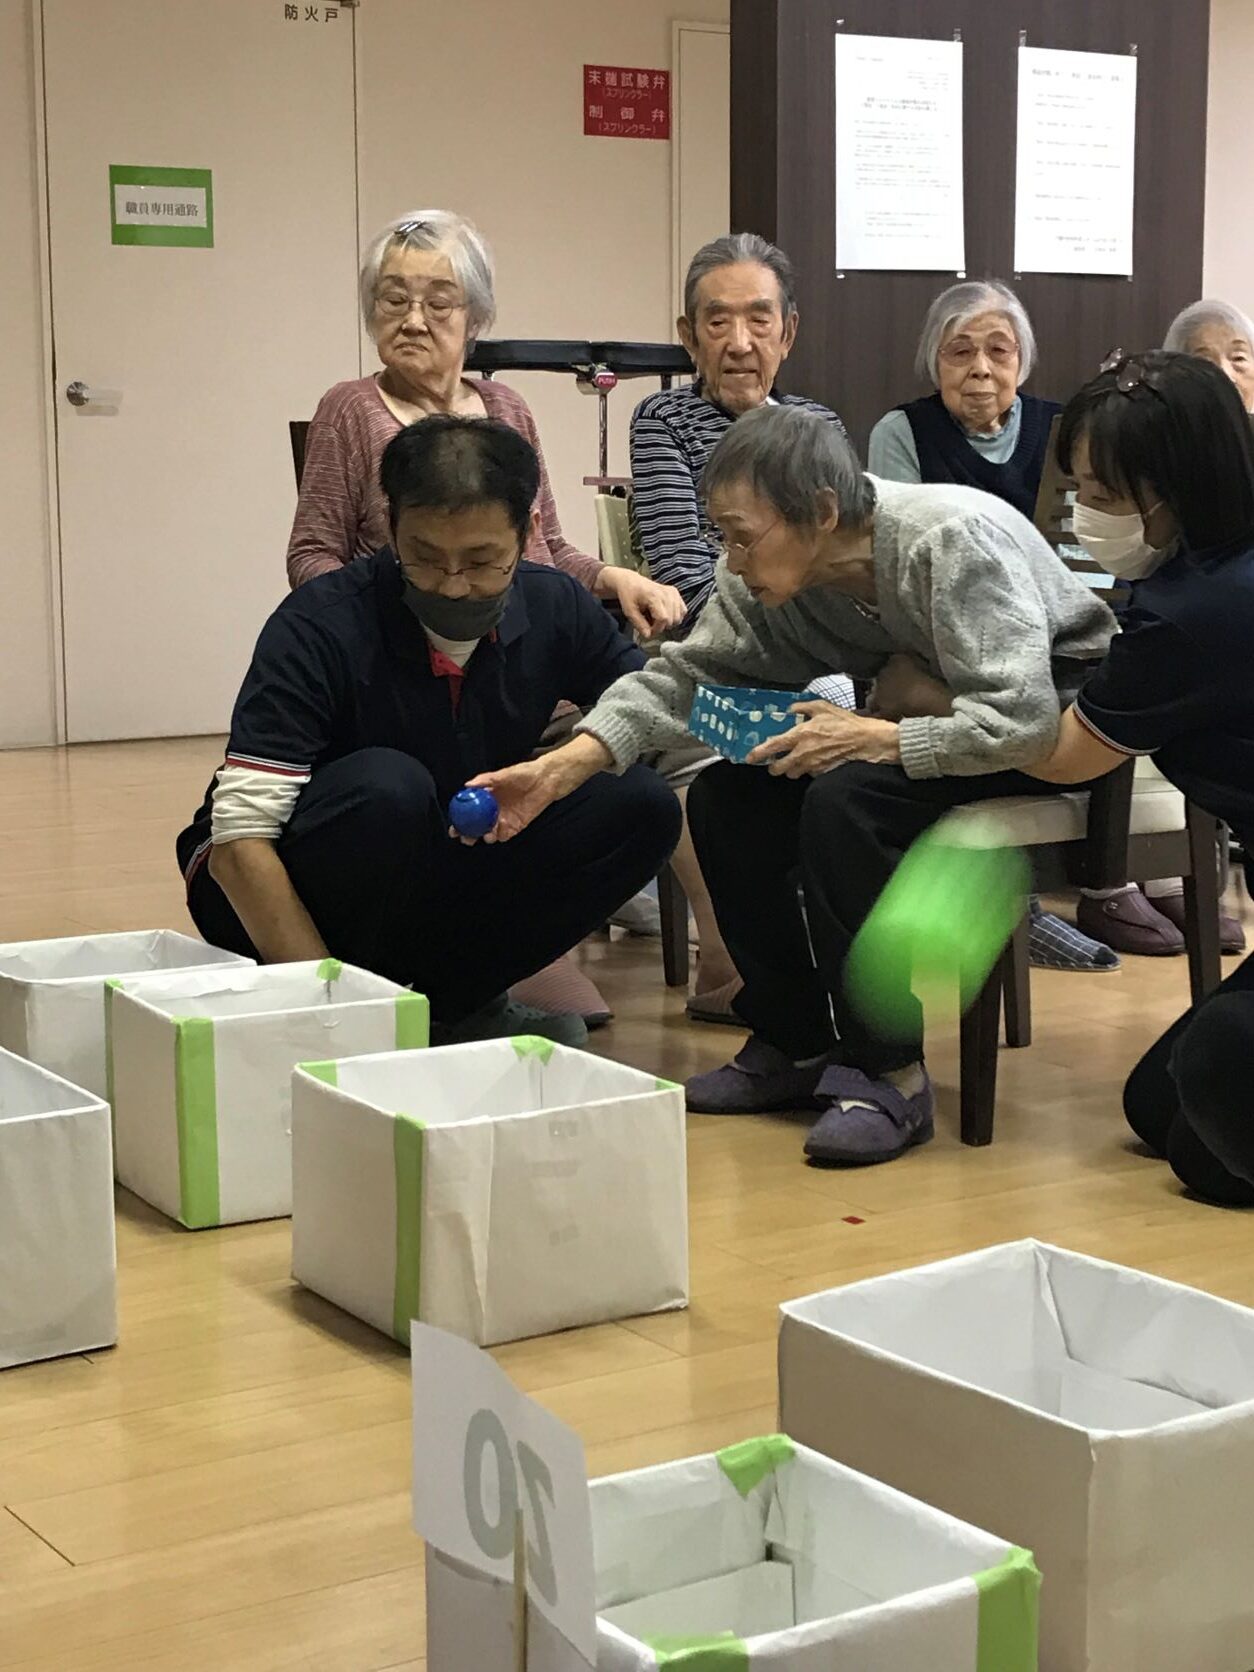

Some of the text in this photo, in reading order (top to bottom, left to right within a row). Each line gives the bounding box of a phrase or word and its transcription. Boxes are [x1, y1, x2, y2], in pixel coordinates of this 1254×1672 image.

[285, 4, 338, 22] 防火戸
[589, 105, 665, 122] 制御弁
[126, 201, 199, 217] 職員専用通路
